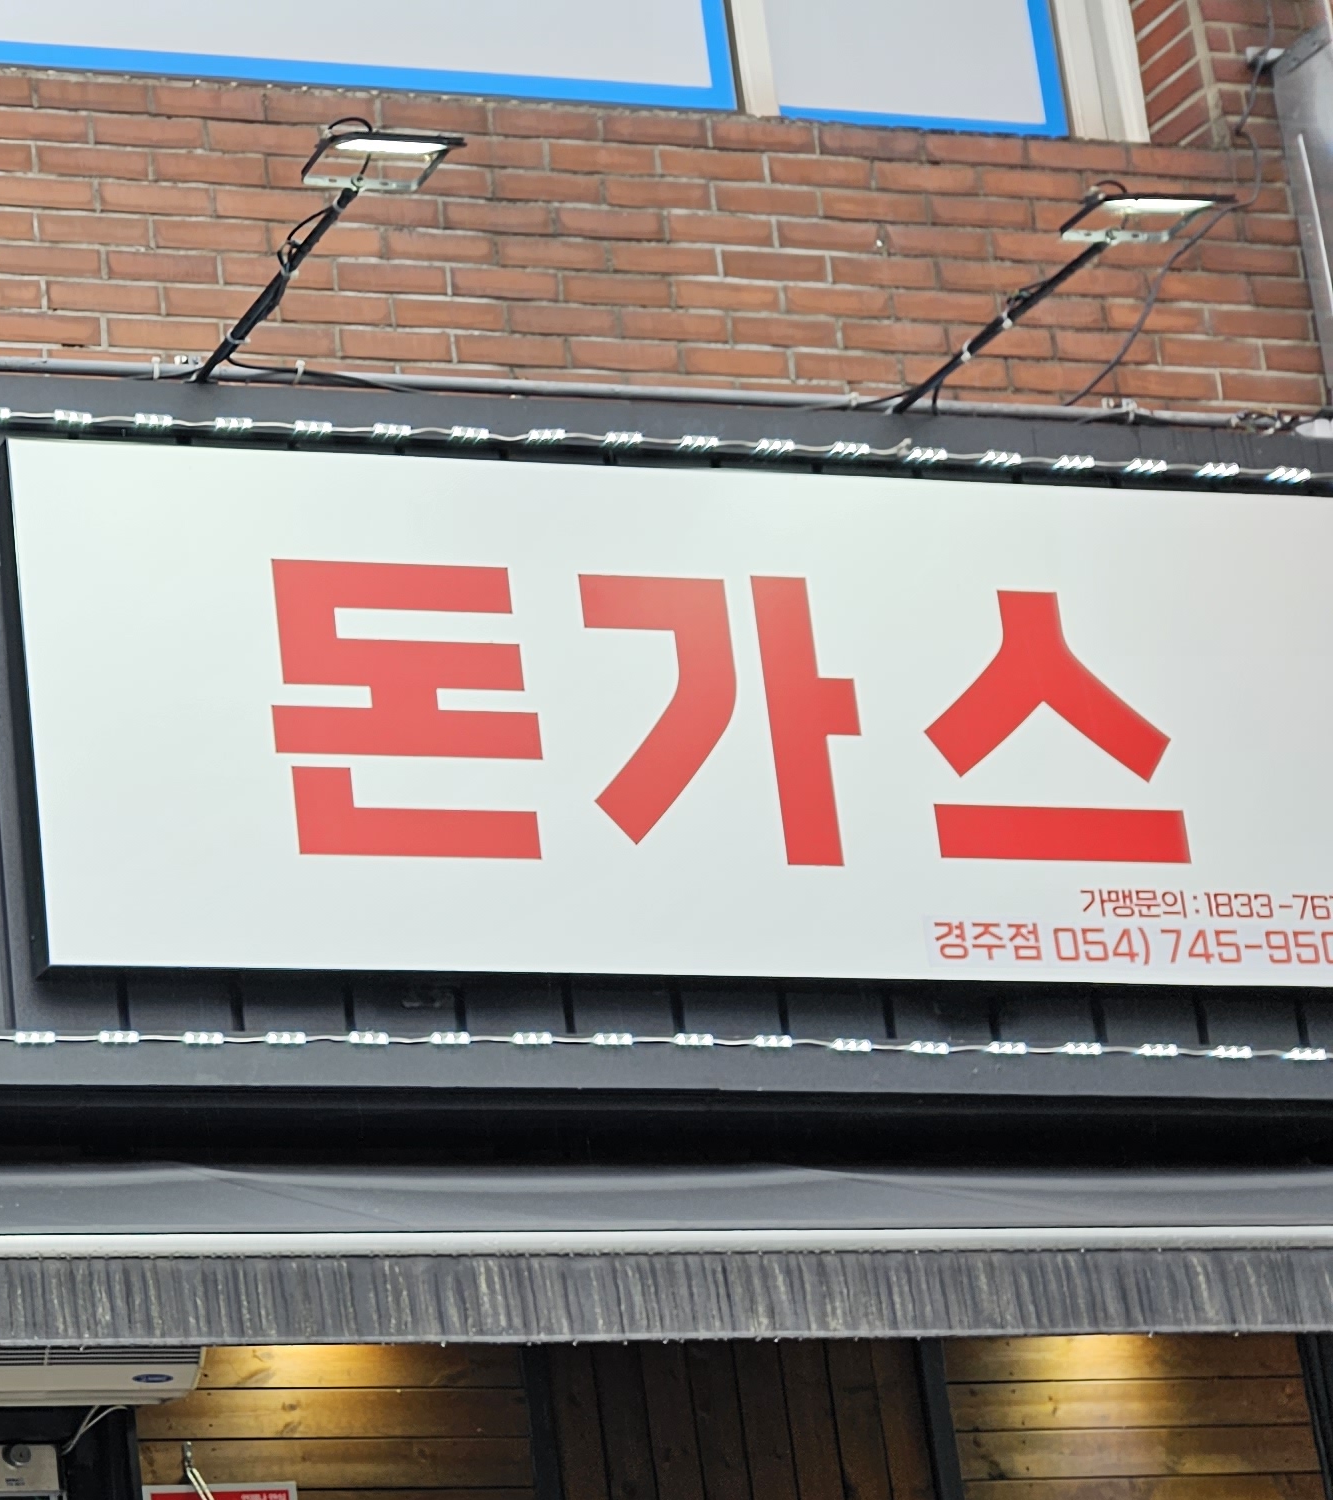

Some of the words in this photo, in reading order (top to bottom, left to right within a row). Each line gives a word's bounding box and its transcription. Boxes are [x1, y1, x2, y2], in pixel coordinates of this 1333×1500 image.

[271, 559, 1191, 866] 돈가스
[933, 921, 1043, 962] 경주점
[1053, 927, 1151, 965] 054)
